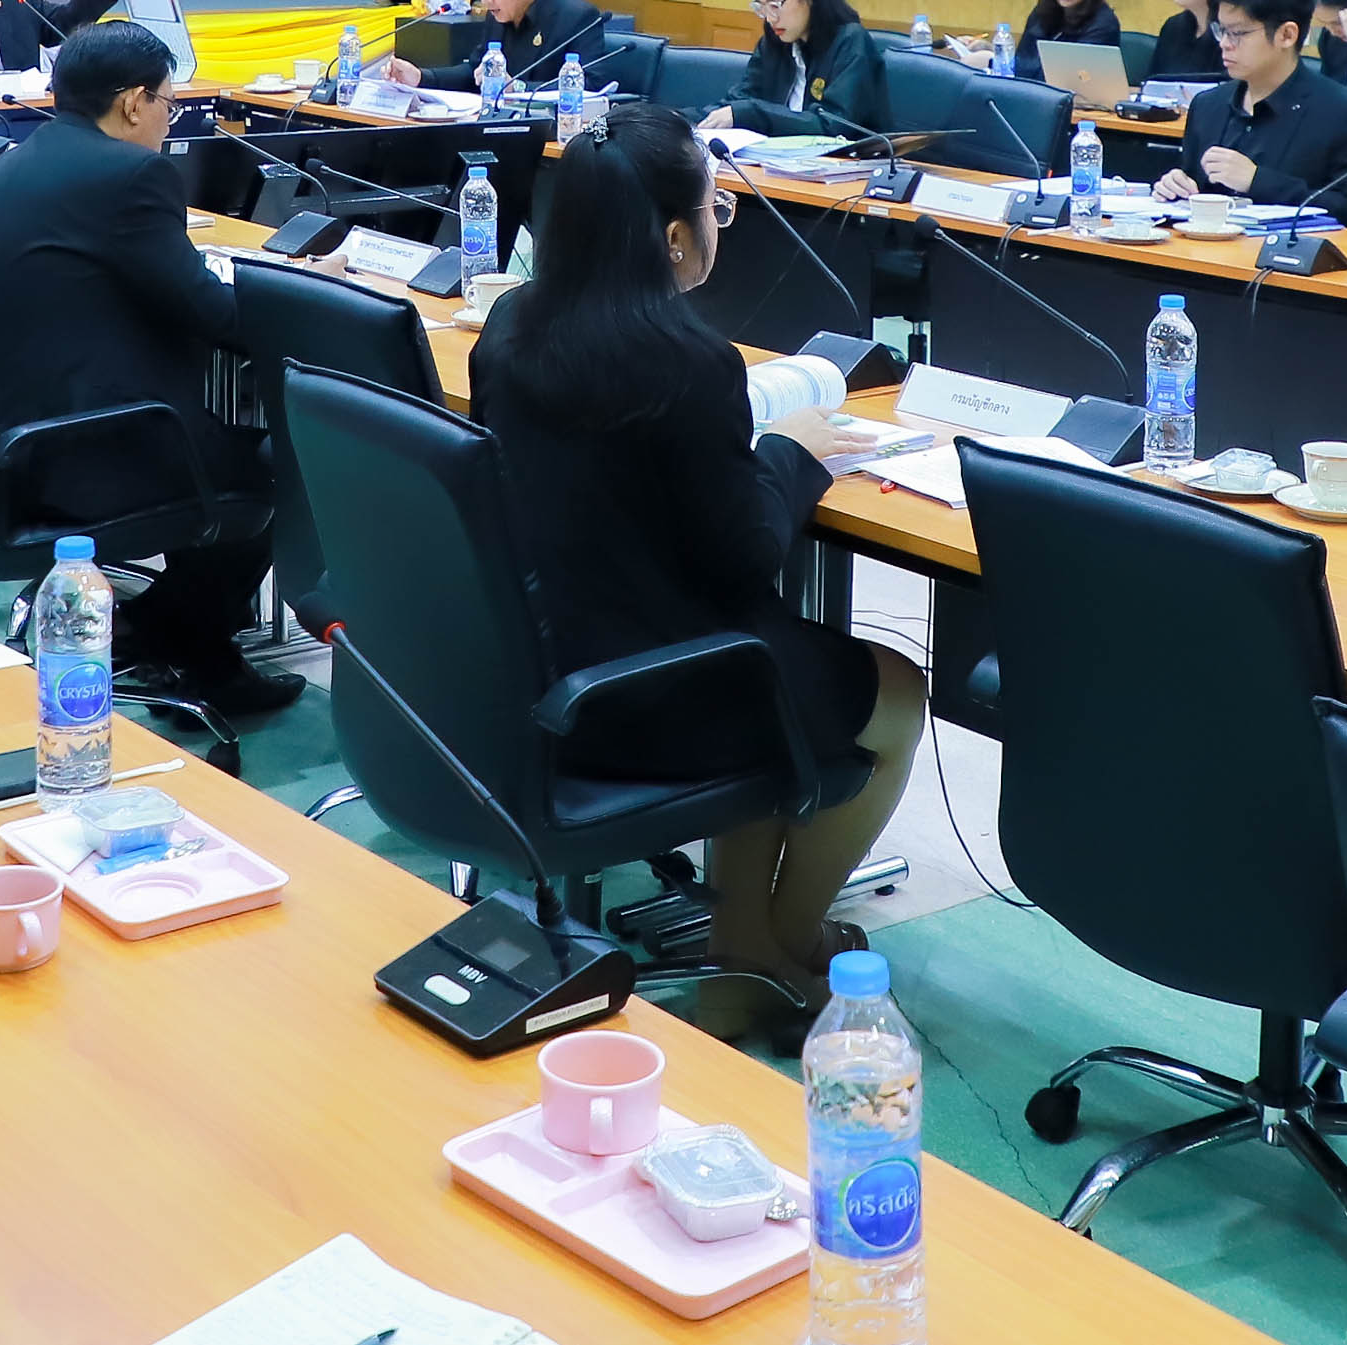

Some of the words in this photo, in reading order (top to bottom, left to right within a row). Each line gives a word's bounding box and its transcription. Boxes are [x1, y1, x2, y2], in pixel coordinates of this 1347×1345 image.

[950, 391, 1011, 416] กรมบัญชีกลาง
